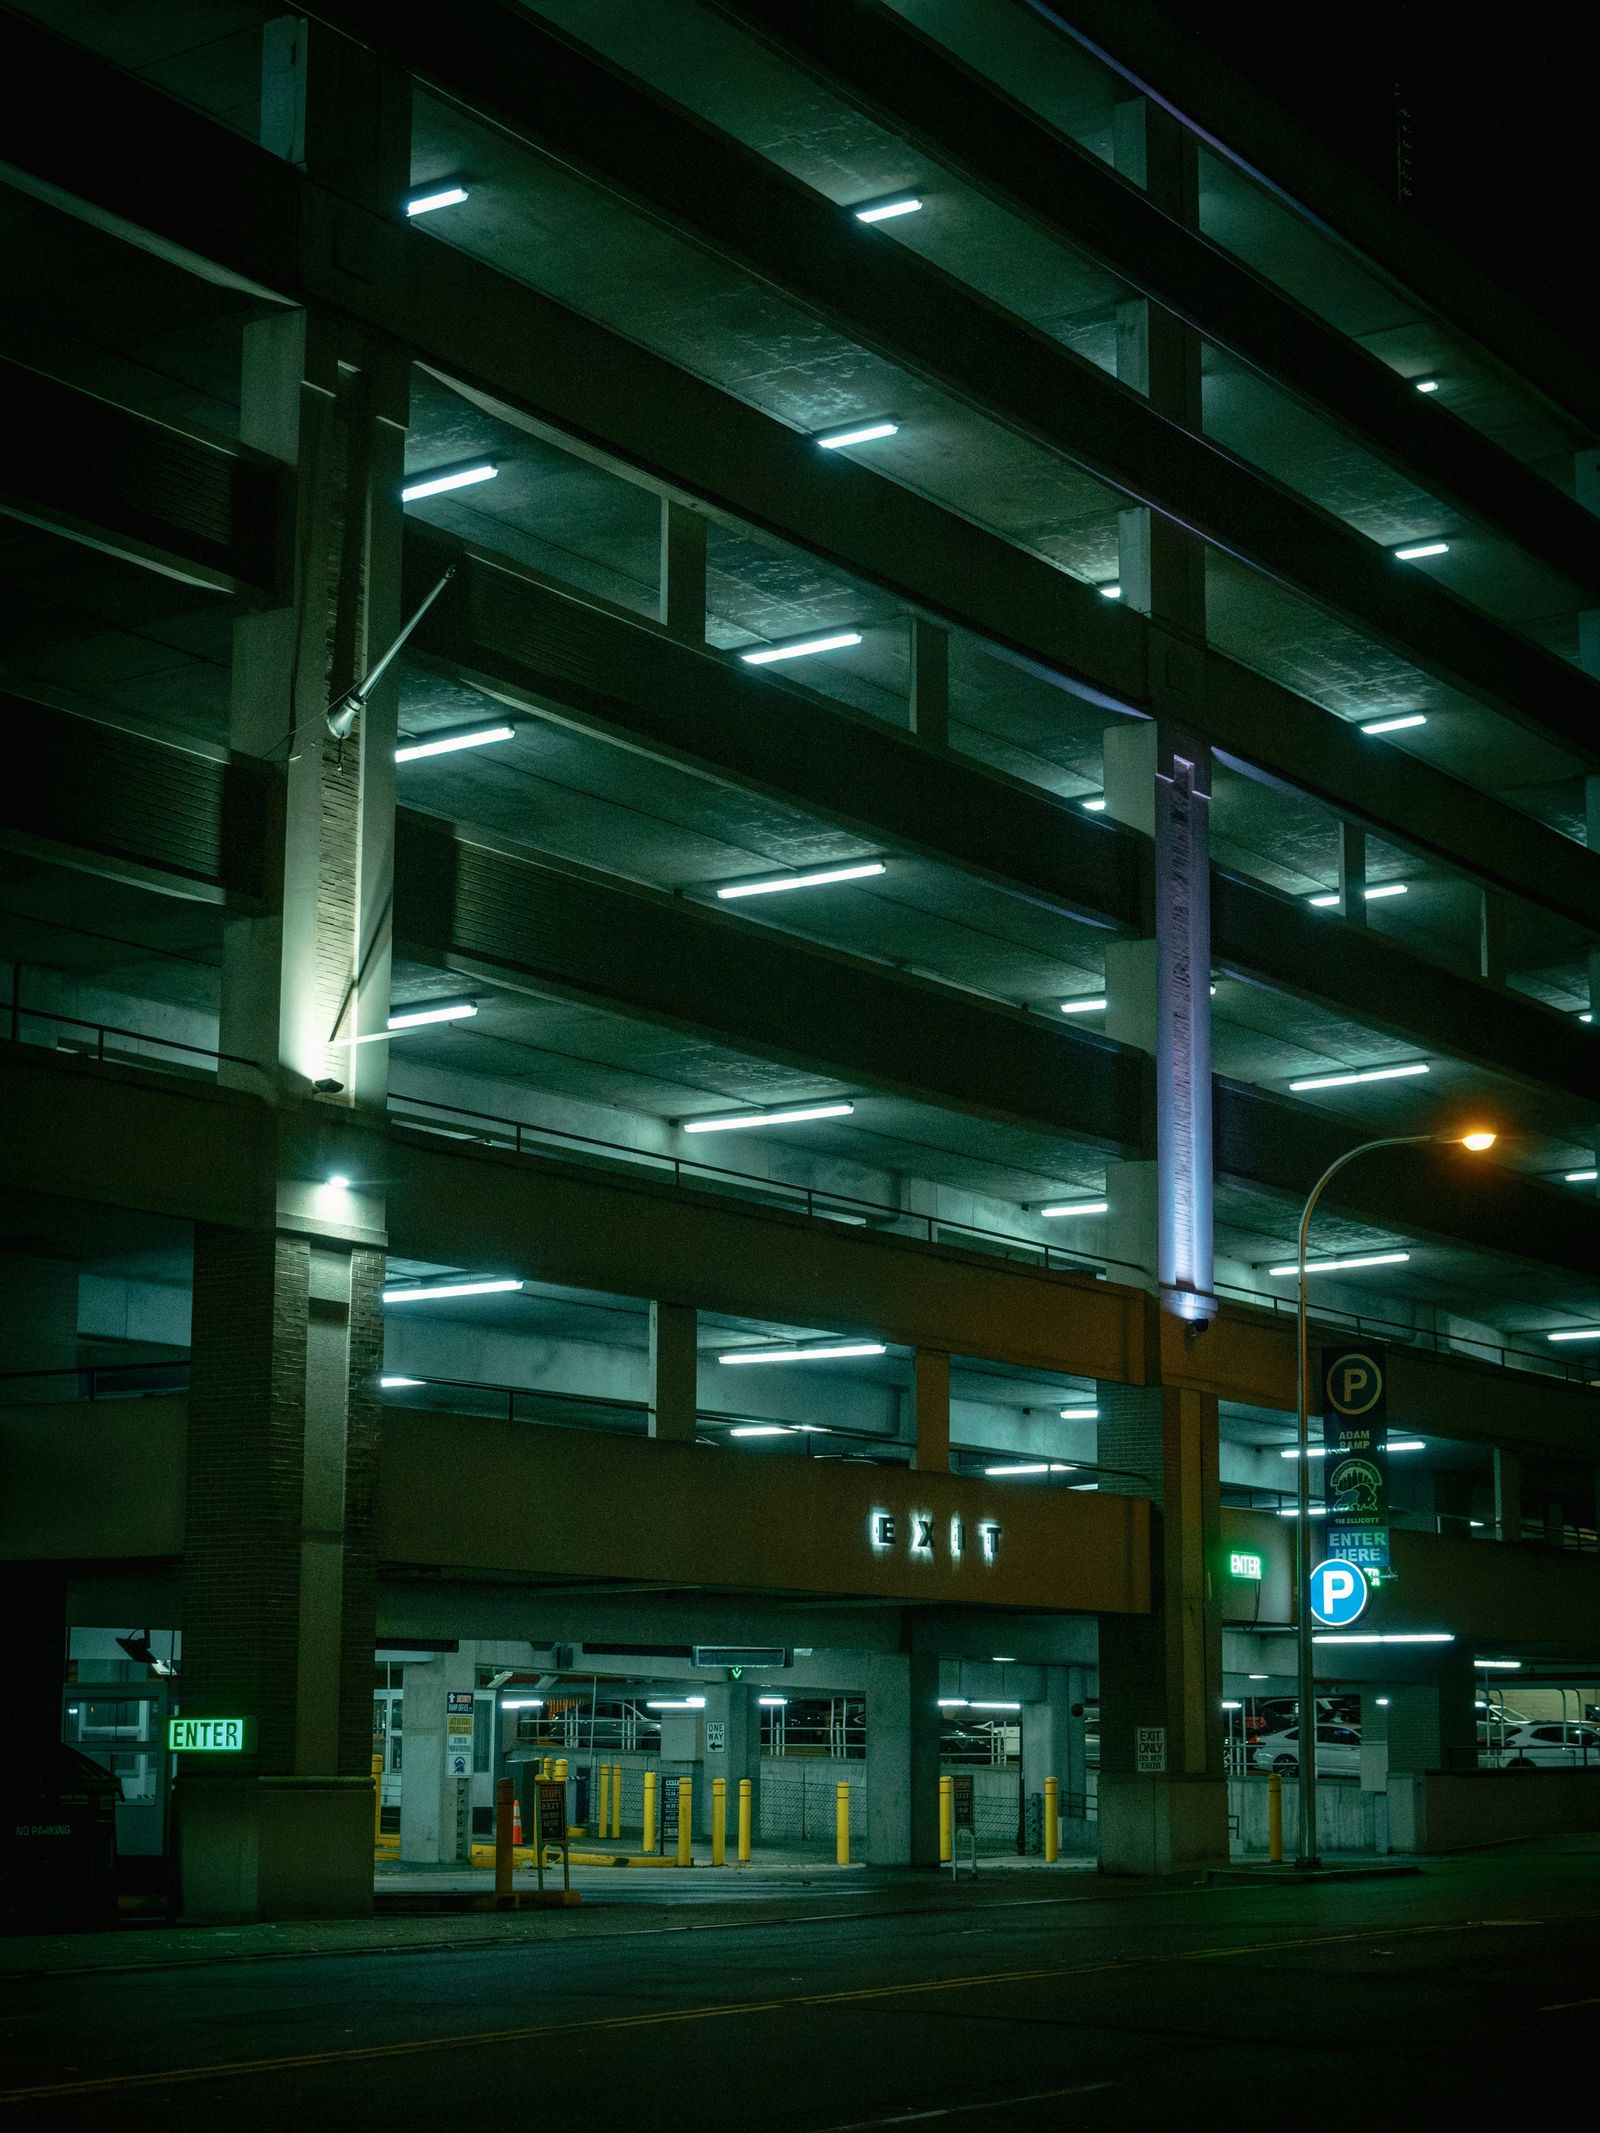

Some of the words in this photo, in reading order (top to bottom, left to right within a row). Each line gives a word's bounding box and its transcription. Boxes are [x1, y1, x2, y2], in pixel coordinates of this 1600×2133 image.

[1343, 1368, 1368, 1403] P
[1339, 1430, 1370, 1440] ADAM
[1340, 1440, 1370, 1450] RAMP
[872, 1510, 1003, 1558] EXIT
[1329, 1532, 1387, 1547] ENTER
[1335, 1548, 1381, 1561] HERE
[1231, 1554, 1261, 1577] ENTER
[1323, 1570, 1355, 1615] P
[708, 1723, 724, 1732] ONE
[173, 1722, 238, 1747] ENTER
[708, 1732, 724, 1741] WAY
[1140, 1731, 1162, 1741] EXIT
[1139, 1742, 1163, 1753] ONLY
[15, 1825, 30, 1837] NO
[31, 1824, 72, 1837] PARKING
